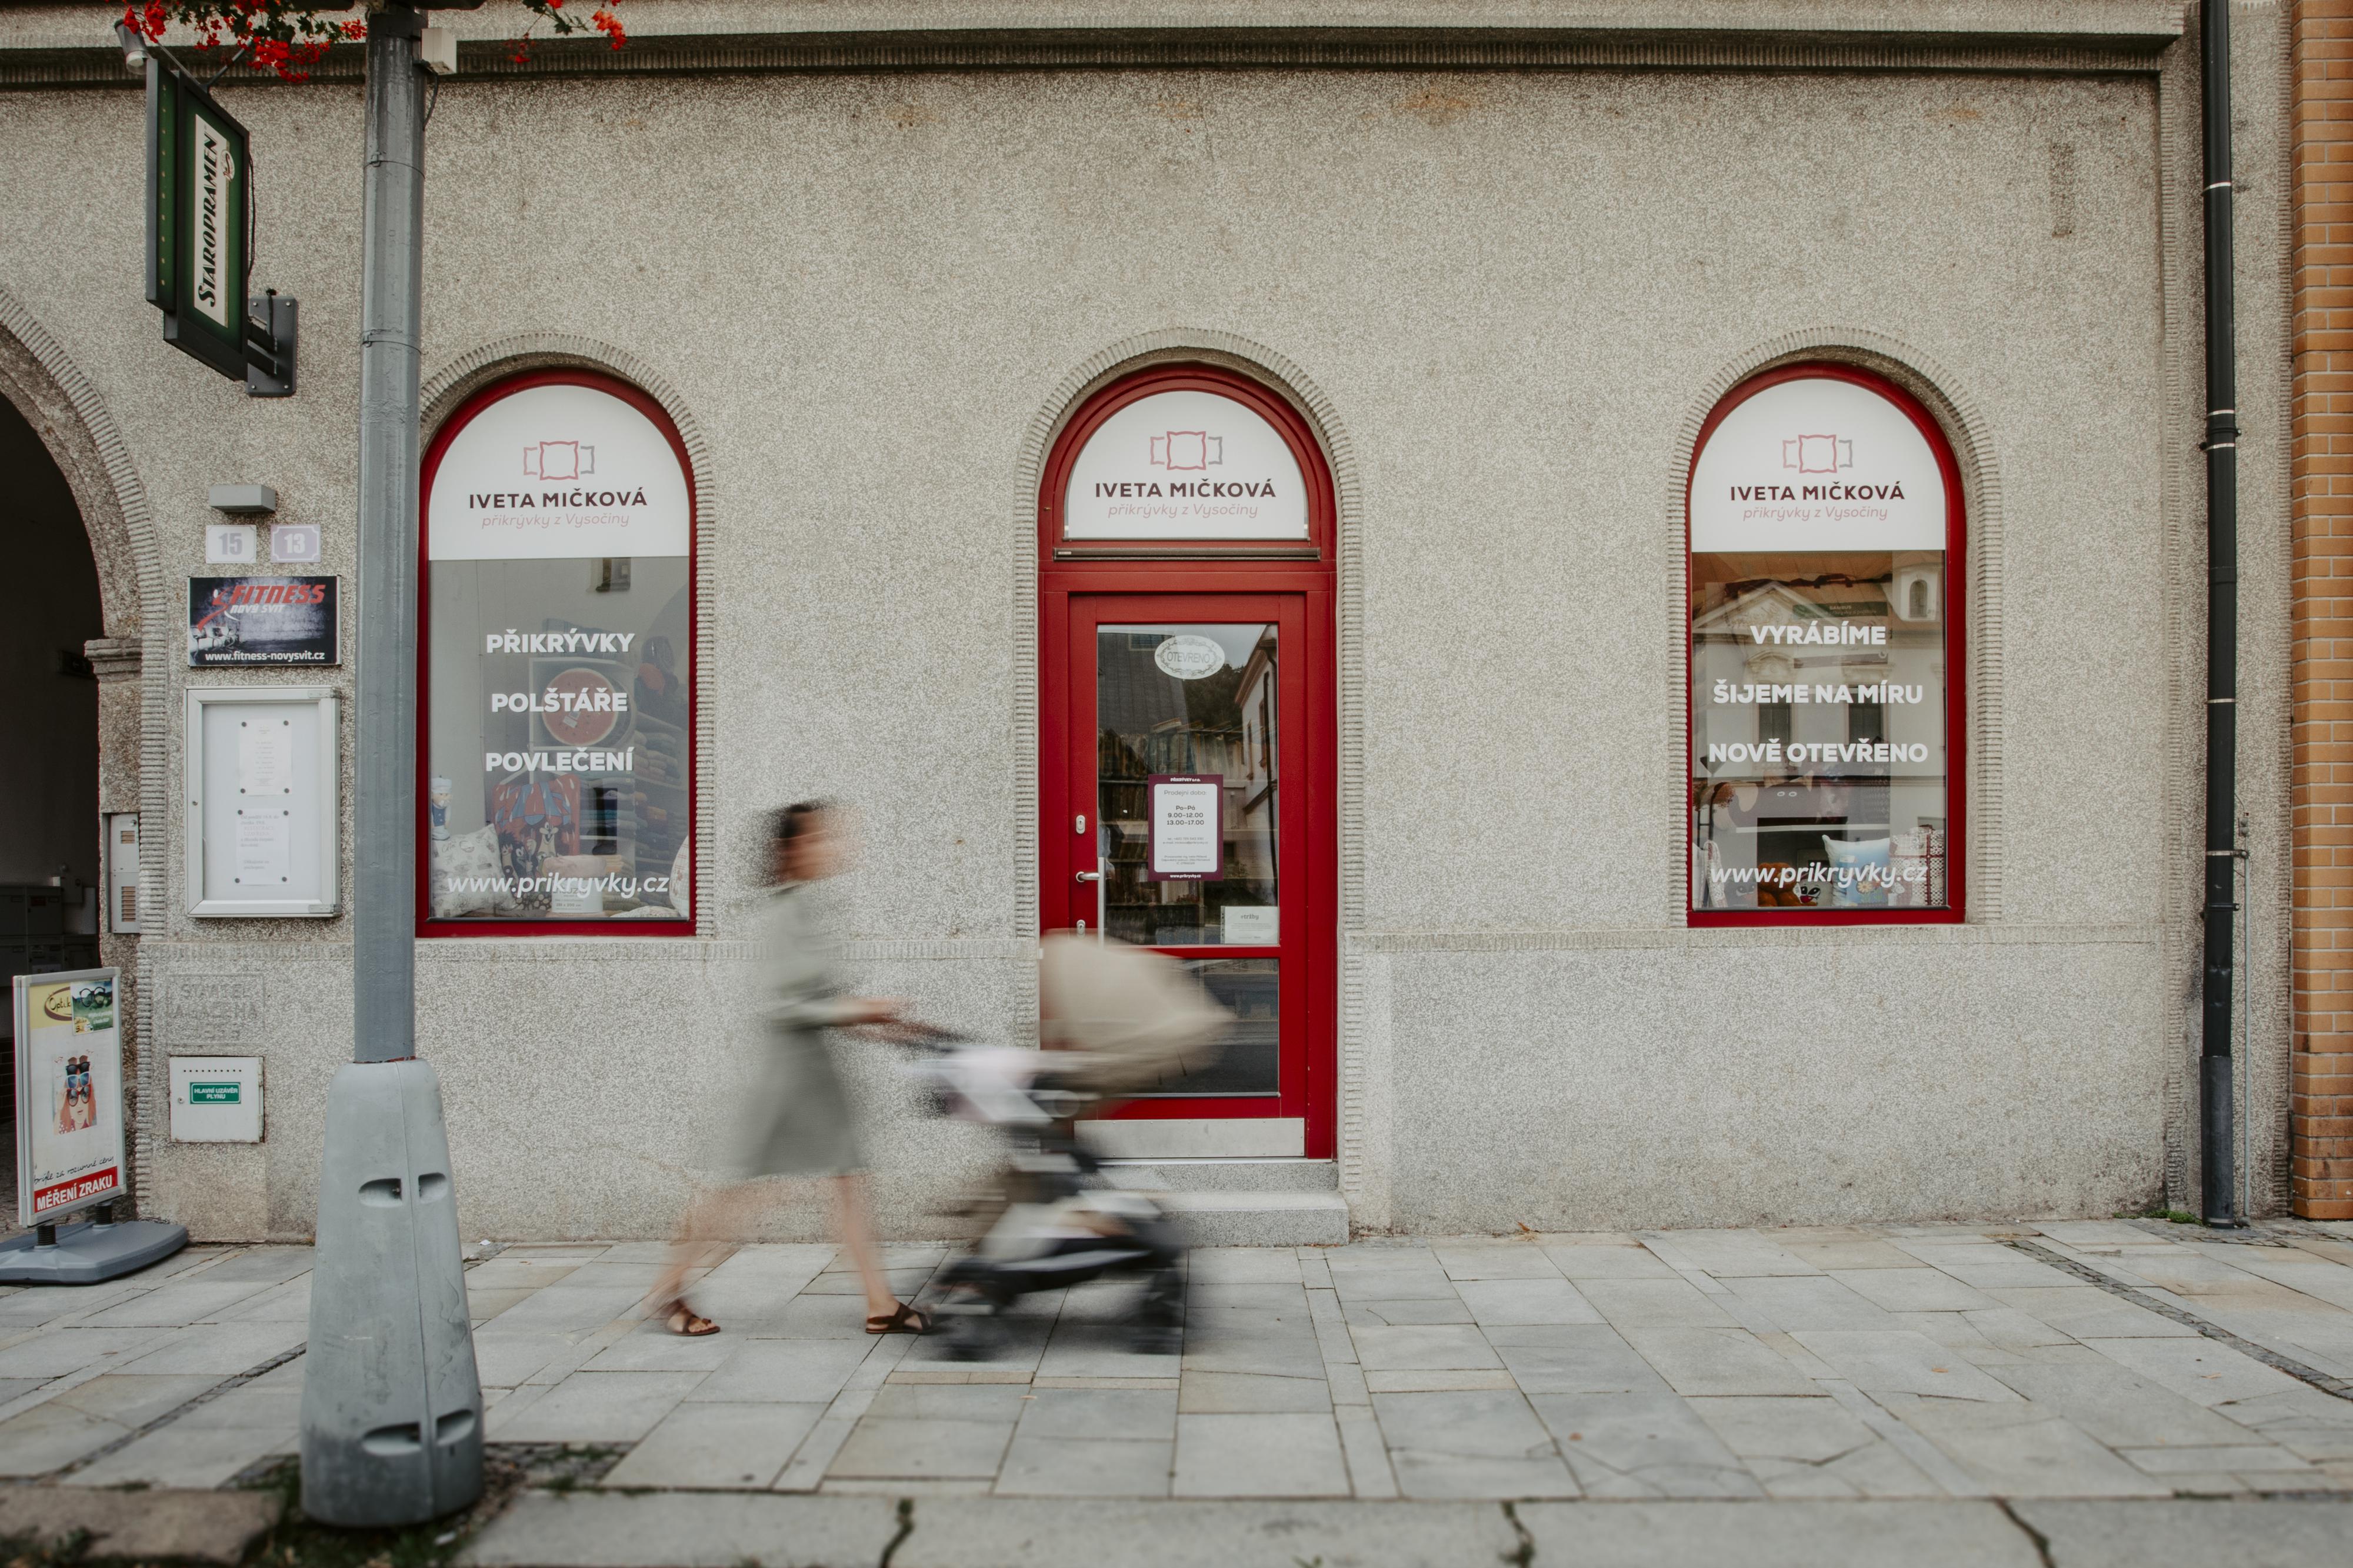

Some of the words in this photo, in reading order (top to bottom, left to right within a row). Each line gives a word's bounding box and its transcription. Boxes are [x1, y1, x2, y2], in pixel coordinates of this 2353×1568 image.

[198, 132, 218, 308] STAROPRAMEN
[469, 493, 536, 509] IVETA
[542, 486, 648, 508] MIČKOVÁ
[1095, 482, 1164, 498] IVETA
[1169, 478, 1277, 498] MIČKOVÁ
[1730, 485, 1797, 502] IVETA
[1802, 480, 1905, 501] MIČKOVÁ
[481, 513, 551, 530] přikrývky
[553, 516, 562, 526] z
[565, 512, 630, 529] Vysočiny
[1107, 503, 1178, 519] přikrývky
[1181, 506, 1189, 516] z
[1193, 502, 1259, 519] Vysočiny
[1742, 506, 1811, 522] přikrývky
[1814, 509, 1822, 518] z
[1825, 505, 1888, 522] Vysočiny
[218, 532, 243, 555] 15
[284, 533, 306, 554] 13
[229, 584, 326, 605] FITNESS
[486, 627, 636, 654] PŘIKRÝVKY
[1749, 620, 1887, 645] VYRÁBÍME
[205, 650, 325, 663] www.fitness-novysvit.cz
[491, 686, 628, 713] POLŠTÁŘE
[1713, 679, 1809, 704] ŠIJEME
[1815, 685, 1853, 703] NA
[1858, 679, 1923, 705] MÍRU
[485, 746, 635, 772] POVLEČENÍ
[1709, 738, 1782, 763] NOVĚ
[1787, 738, 1929, 763] OTEVŘENO
[447, 872, 669, 900] www.prikryvky.cz
[1709, 862, 1929, 889] www.prikryvky.cz
[36, 1183, 78, 1211] MĚŘENÍ
[79, 1175, 113, 1197] ZRAKU
